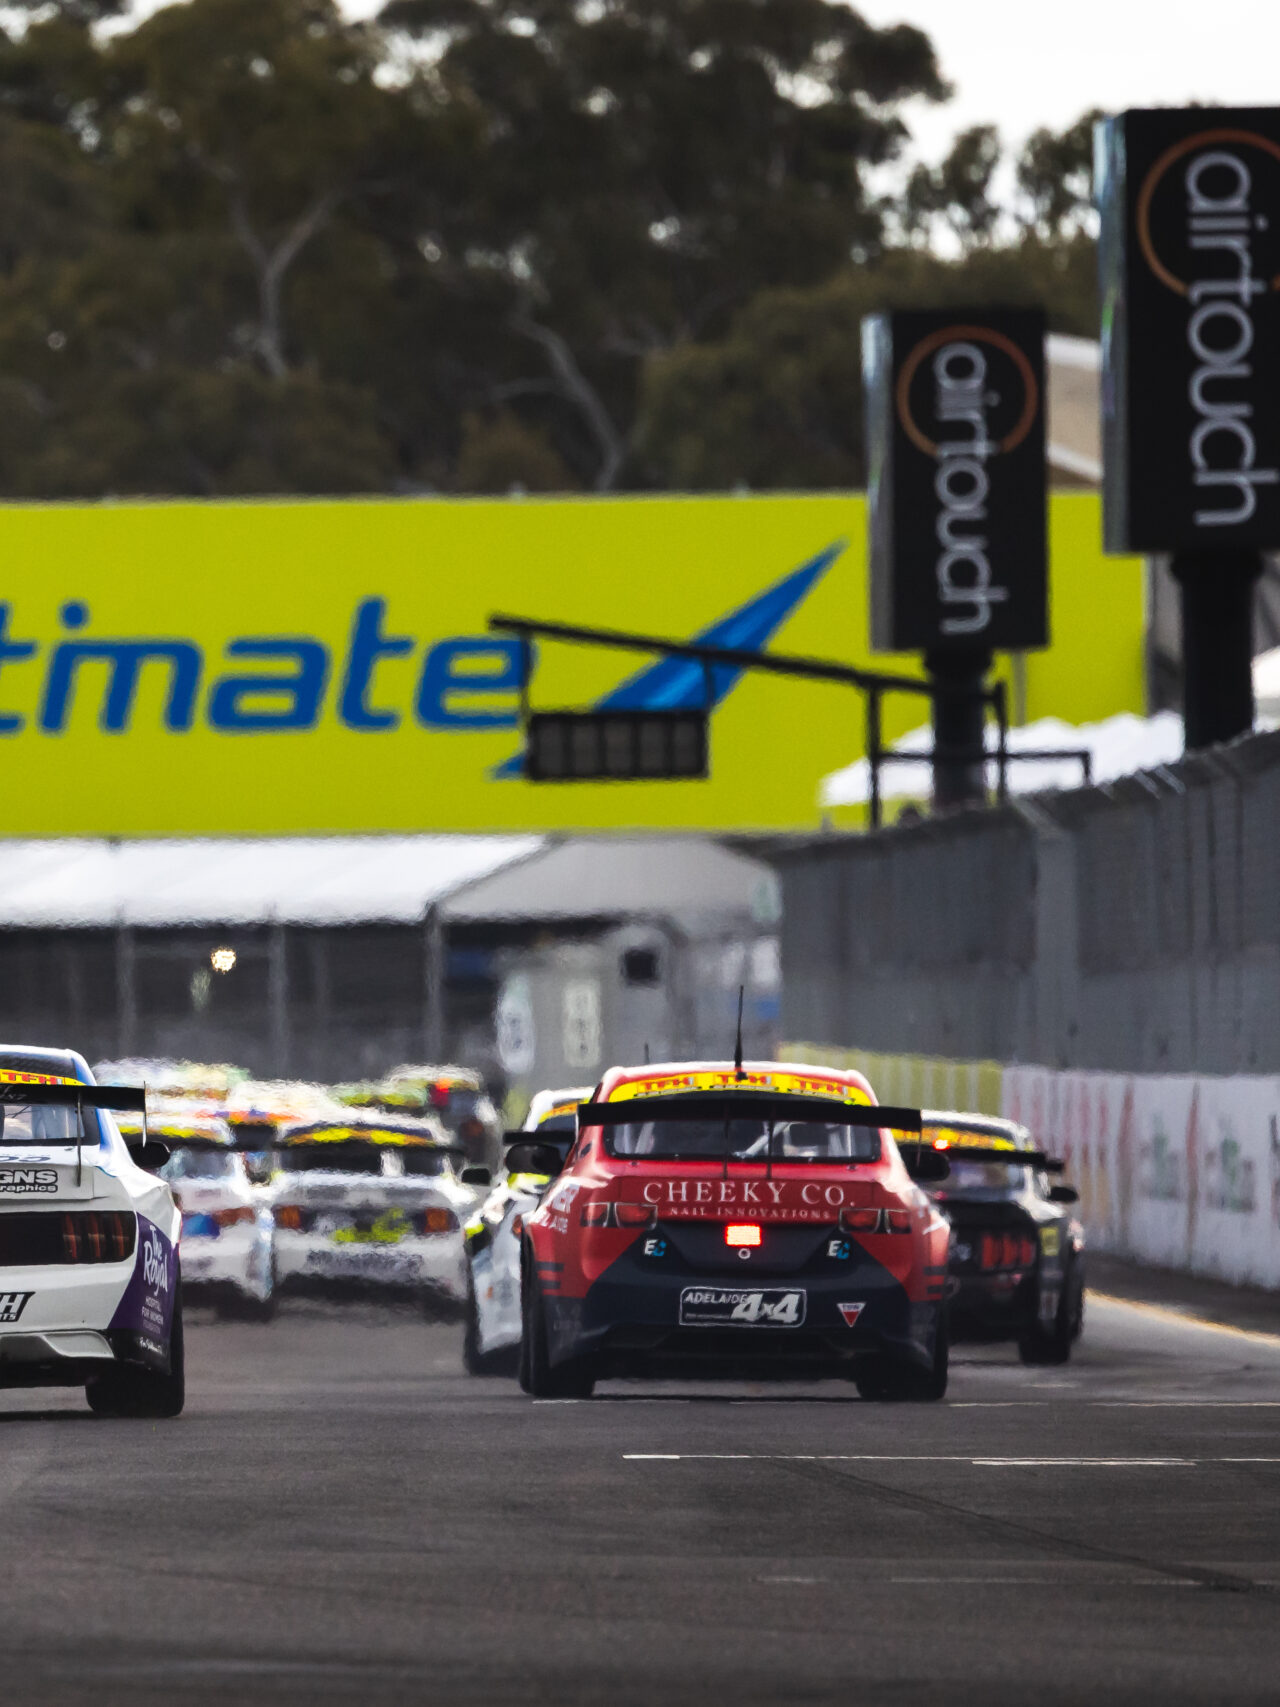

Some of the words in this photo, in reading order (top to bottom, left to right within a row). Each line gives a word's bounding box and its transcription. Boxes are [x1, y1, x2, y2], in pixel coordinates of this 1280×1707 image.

[1185, 151, 1279, 527] airtouch
[933, 342, 1008, 635] airtouch
[2, 1072, 60, 1085] TFH
[640, 1077, 689, 1091] TFH
[794, 1079, 844, 1094] TFH
[643, 1181, 787, 1204] CHEEKY
[801, 1183, 855, 1207] CO.
[670, 1206, 707, 1217] NAIL
[717, 1207, 832, 1219] INNOVATIONS
[149, 1224, 163, 1260] The
[143, 1240, 168, 1297] Royal
[684, 1292, 748, 1305] ADELAIDE
